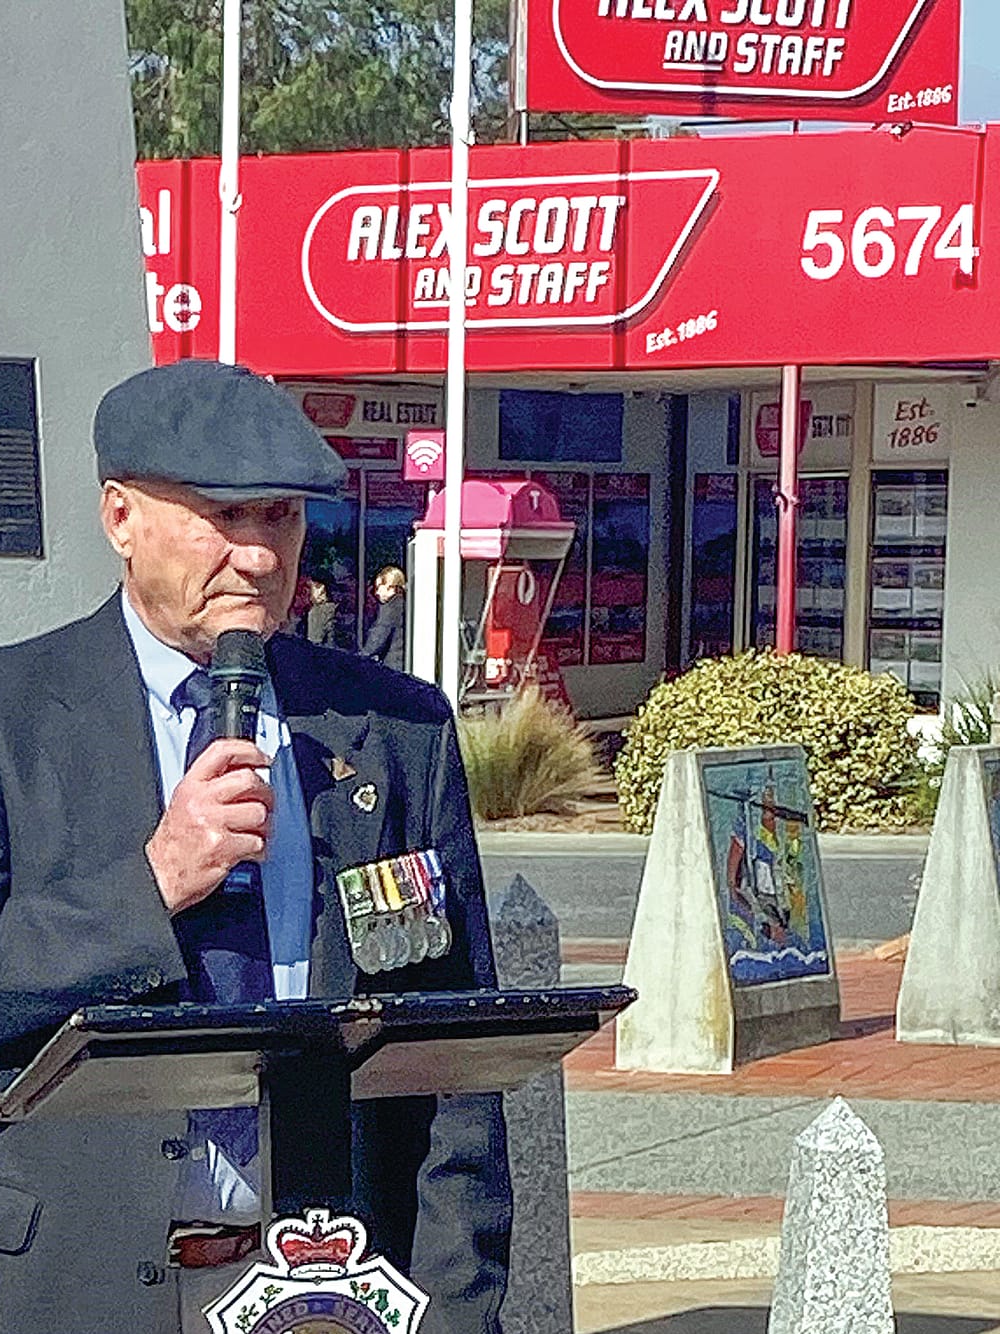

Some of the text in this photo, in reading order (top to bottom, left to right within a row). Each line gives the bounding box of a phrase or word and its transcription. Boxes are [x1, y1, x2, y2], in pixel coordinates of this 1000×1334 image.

[663, 30, 846, 76] AND STAFF
[347, 196, 626, 261] ALEX SCOTT
[800, 203, 981, 280] 5674
[413, 261, 609, 307] AND STAFF
[894, 396, 935, 422] Est.
[887, 422, 941, 450] 1886
